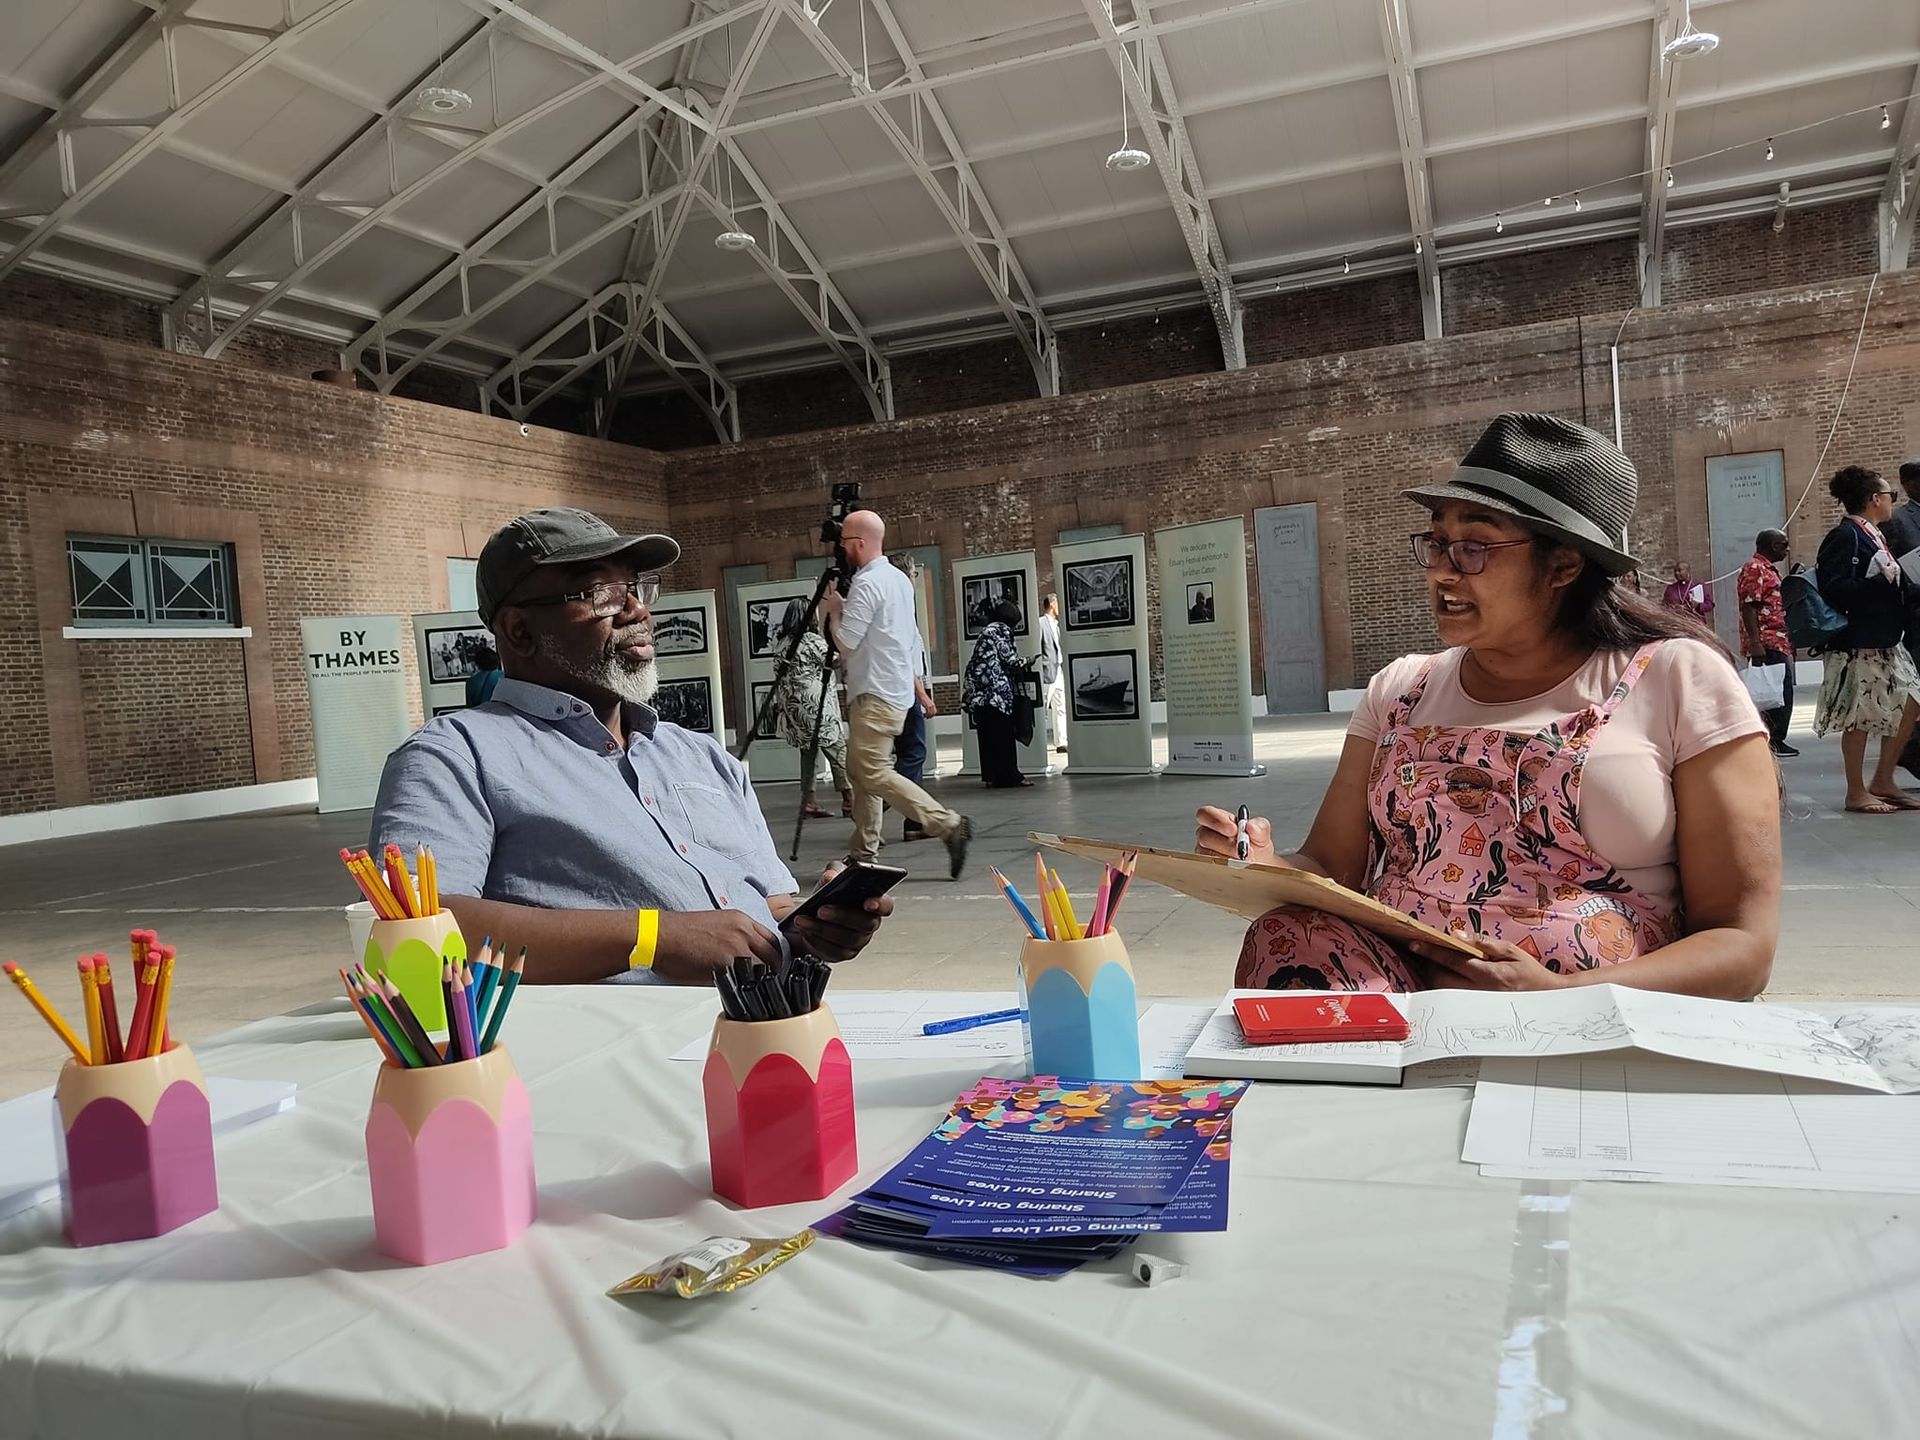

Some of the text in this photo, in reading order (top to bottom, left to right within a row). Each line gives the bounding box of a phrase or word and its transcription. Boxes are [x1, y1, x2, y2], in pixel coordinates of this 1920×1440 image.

[340, 631, 367, 647] BY
[309, 650, 400, 669] THAMES
[966, 1180, 1117, 1199] Sharing Our Lives
[929, 1194, 1086, 1212] Sharing Our Lives
[992, 1226, 1041, 1234] Lives
[1088, 1223, 1162, 1231] Sharing
